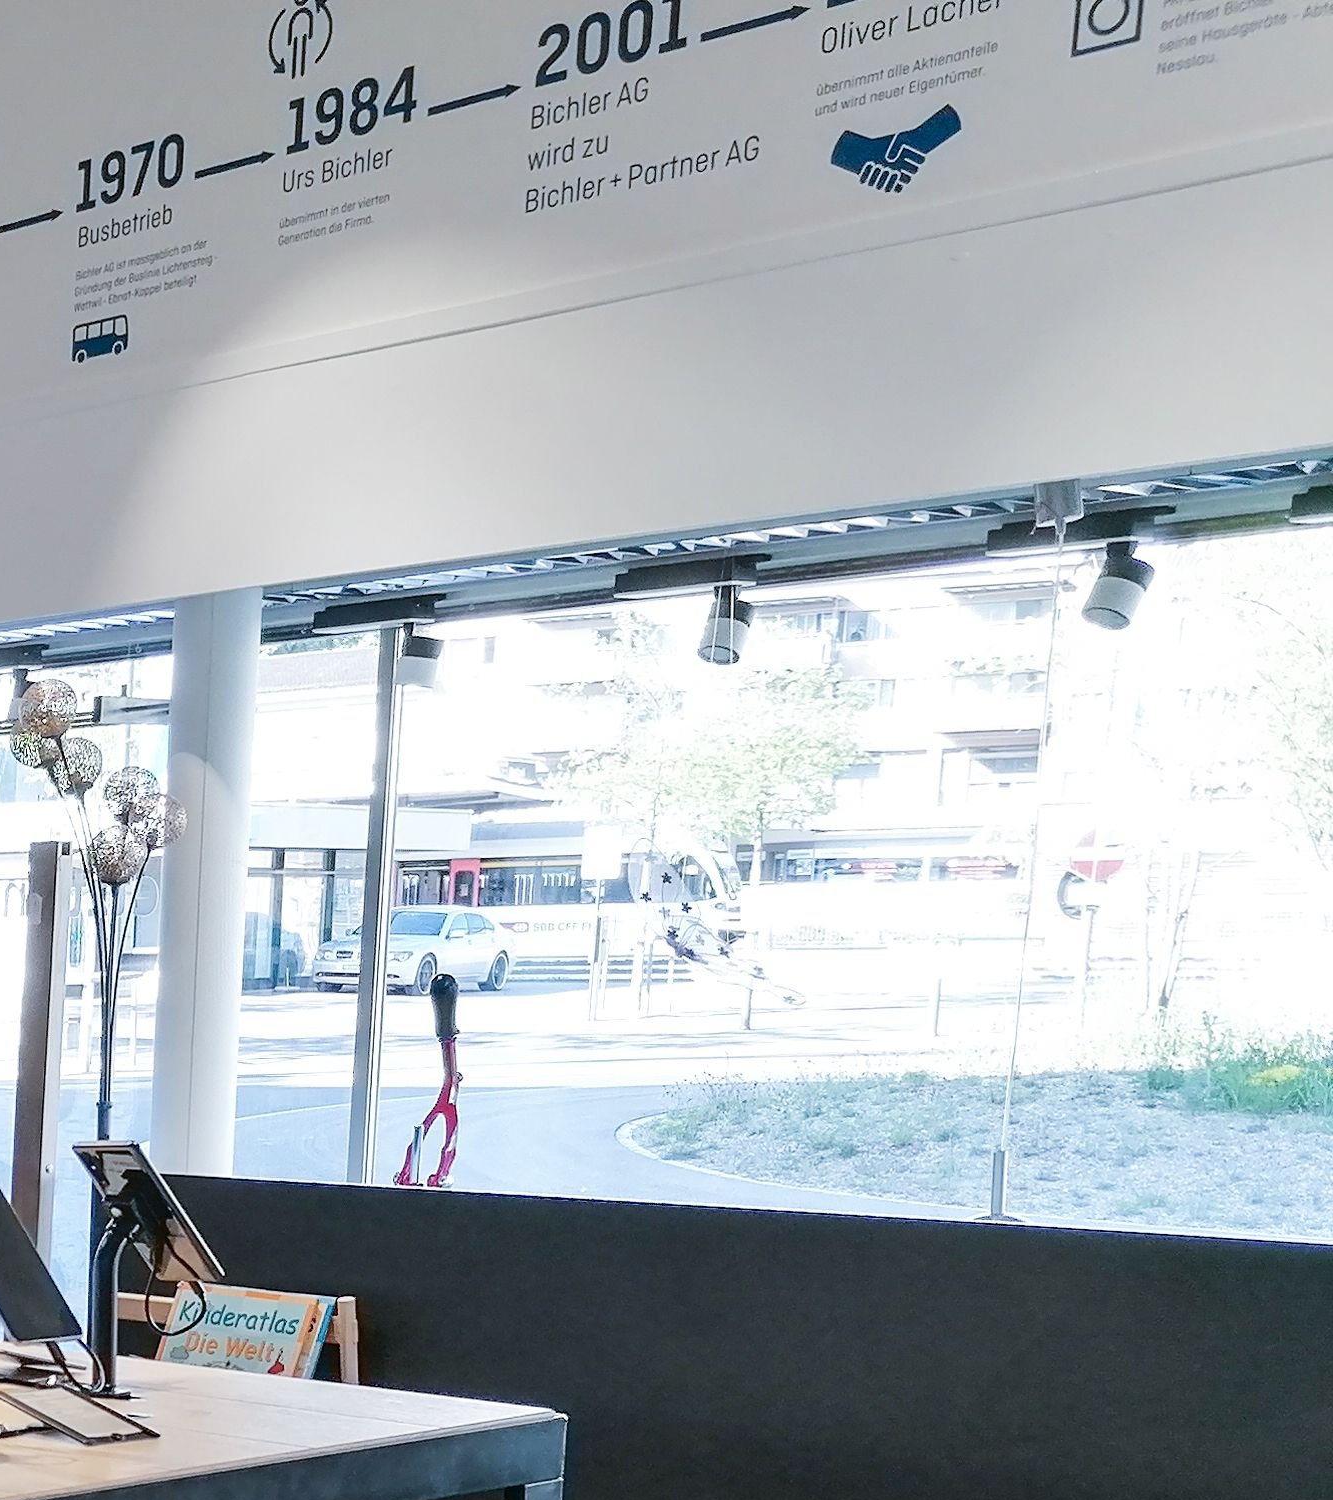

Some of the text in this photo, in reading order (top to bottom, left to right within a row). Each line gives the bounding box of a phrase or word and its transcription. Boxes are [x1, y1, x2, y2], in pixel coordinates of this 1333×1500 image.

[535, 0, 688, 88] 2001
[822, 15, 898, 54] Oliver
[816, 40, 999, 97] übernimmt alle Aktienanteile
[286, 65, 417, 155] 1984
[530, 77, 650, 130] Bichler AG
[814, 99, 838, 117] und
[840, 92, 866, 110] wird
[869, 86, 904, 104] neuer
[76, 133, 185, 213] 1970
[282, 148, 393, 193] Urs Bichler
[524, 177, 606, 214] Bichler
[628, 149, 721, 190] Partner
[725, 135, 761, 167] AG
[528, 135, 610, 171] wird zu
[340, 200, 357, 214] der
[358, 193, 391, 210] vierten
[78, 204, 173, 248] Busbetrieb
[328, 220, 343, 234] die
[184, 1330, 220, 1354] Die
